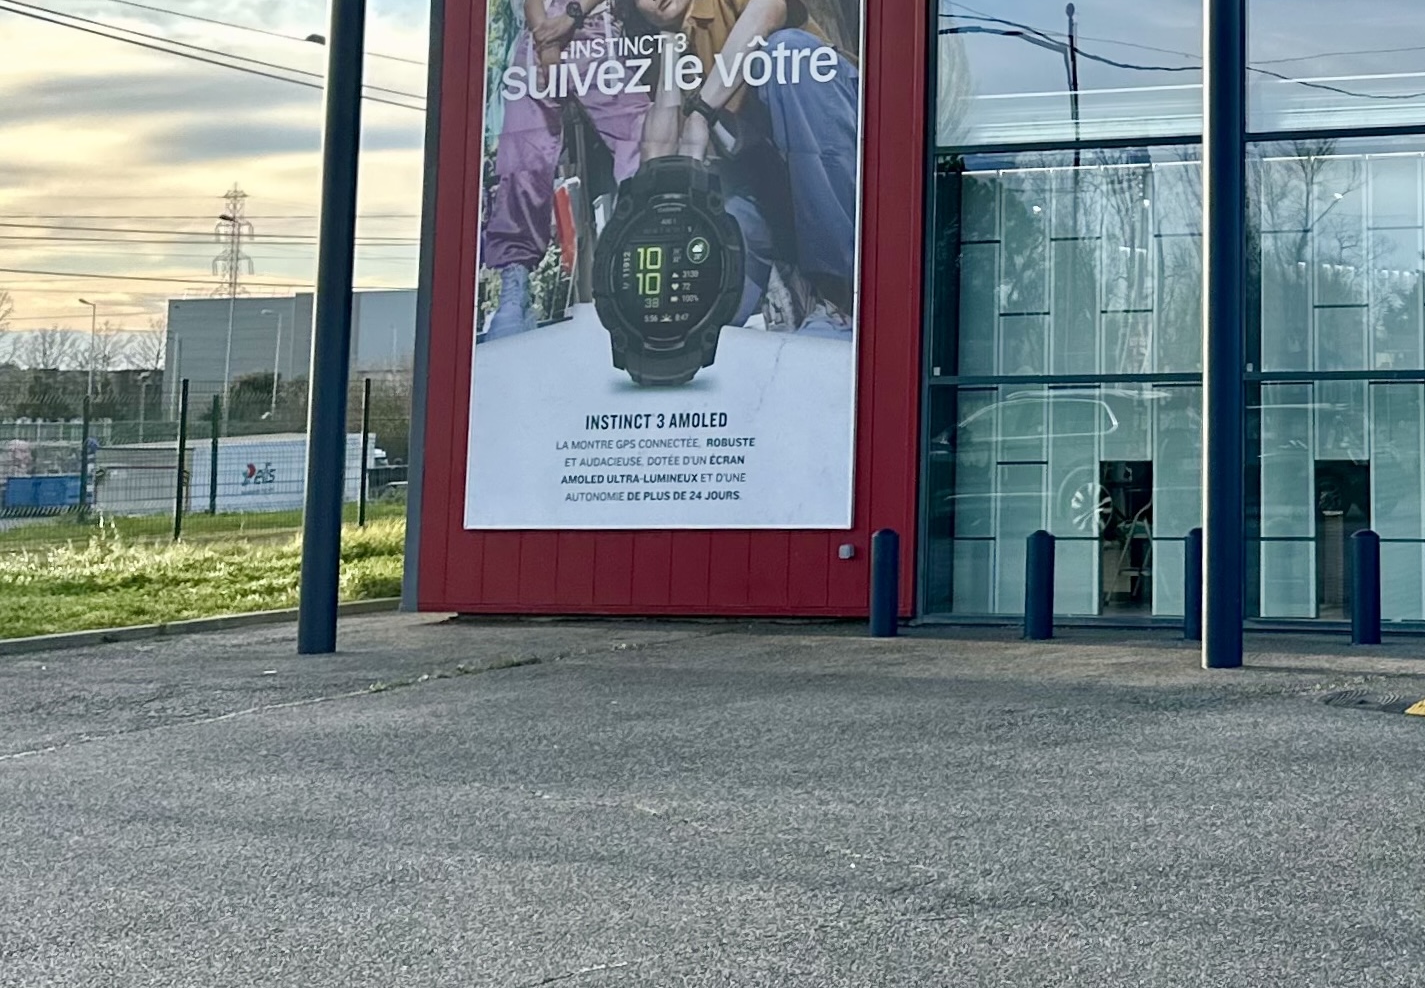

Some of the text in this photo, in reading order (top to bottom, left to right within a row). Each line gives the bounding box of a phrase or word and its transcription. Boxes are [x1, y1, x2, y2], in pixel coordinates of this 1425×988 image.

[569, 32, 687, 60] INSTINCT 3
[501, 38, 838, 102] suivez le vôtre
[637, 247, 662, 270] 10
[635, 272, 661, 296] 10
[585, 412, 728, 430] INSTINCT 3 AMOLED
[555, 440, 569, 450] LA
[571, 439, 613, 450] MONTRE
[615, 439, 636, 449] GPS
[706, 437, 756, 448] ROBUSTE
[564, 457, 577, 468] ET
[647, 454, 680, 466] DOTÉE
[709, 453, 745, 465] ÉCRAN
[560, 474, 605, 485] AMOLED
[606, 473, 698, 484] ULTRA-LUMINEUX
[700, 473, 713, 483] ET
[565, 491, 626, 502] AUTONOMIE
[627, 491, 641, 501] DE
[643, 491, 671, 501] PLUS
[673, 491, 687, 501] DE
[689, 491, 702, 501] 24
